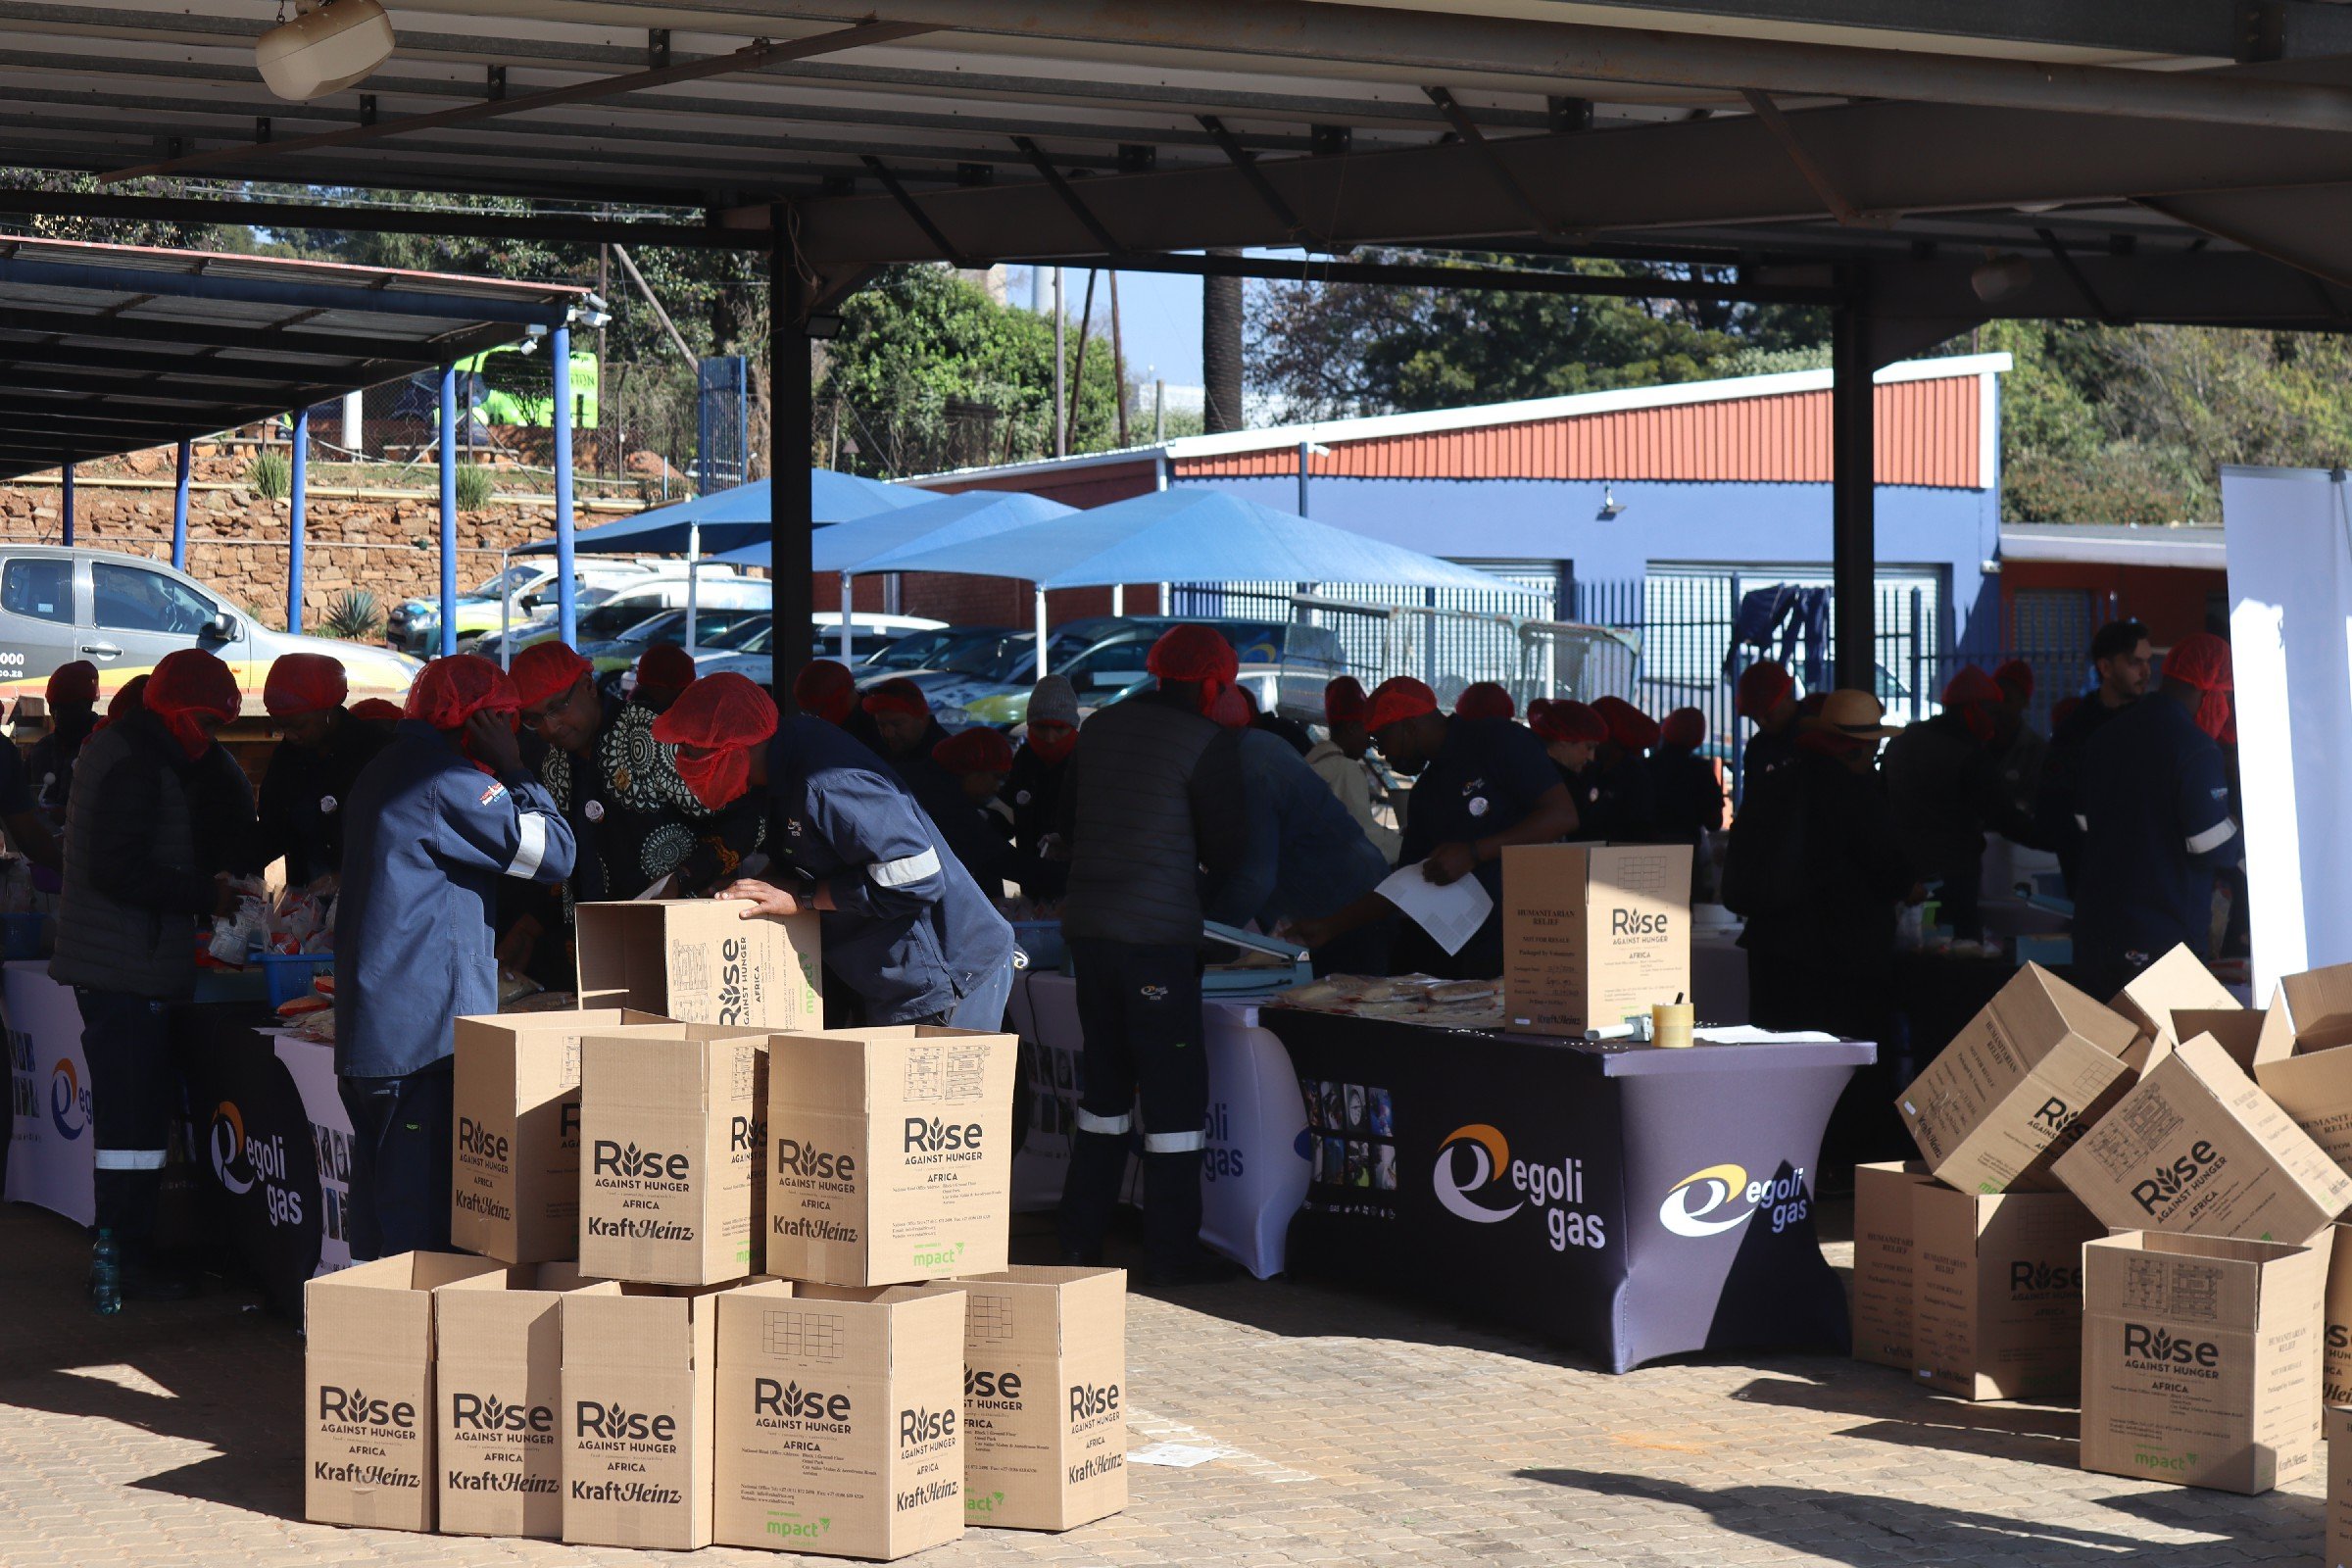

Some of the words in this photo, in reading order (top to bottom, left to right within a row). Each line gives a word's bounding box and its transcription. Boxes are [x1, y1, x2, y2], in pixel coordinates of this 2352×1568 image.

[1612, 937, 1640, 946] AGAINST
[1203, 1102, 1228, 1142] oli
[245, 1134, 286, 1182] egoli
[459, 1153, 484, 1166] AGAINST
[485, 1161, 509, 1175] HUNGER
[905, 1153, 943, 1165] AGAINST
[946, 1152, 983, 1162] HUNGER
[473, 1175, 493, 1188] AFRICA
[594, 1178, 642, 1189] AGAINST
[644, 1181, 690, 1193] HUNGER
[778, 1177, 816, 1191] AGAINST
[818, 1181, 856, 1195] HUNGER
[927, 1173, 958, 1183] AFRICA
[1512, 1156, 1584, 1206] egoli
[1745, 1167, 1803, 1204] egoli
[2157, 1188, 2192, 1224] AGAINST
[2190, 1155, 2228, 1192] HUNGER
[267, 1183, 303, 1227] gas
[622, 1200, 660, 1210] AFRICA
[801, 1199, 831, 1211] AFRICA
[2189, 1191, 2220, 1219] AFRICA
[1772, 1196, 1807, 1234] gas
[1547, 1209, 1606, 1252] gas
[913, 1249, 956, 1268] mpact
[2125, 1359, 2170, 1372] AGAINST
[2173, 1365, 2219, 1380] HUNGER
[2151, 1382, 2189, 1395] AFRICA
[977, 1401, 1023, 1411] HUNGER
[756, 1418, 803, 1430] AGAINST
[805, 1422, 852, 1435] HUNGER
[964, 1419, 993, 1429] FRICA
[1071, 1420, 1096, 1435] AGAINST
[1097, 1411, 1120, 1428] HUNGER
[320, 1424, 367, 1436] AGAINST
[370, 1428, 416, 1441] HUNGER
[454, 1432, 502, 1442] AGAINST
[507, 1434, 554, 1445] HUNGER
[577, 1441, 626, 1451] AGAINST
[629, 1444, 677, 1454] HUNGER
[783, 1441, 821, 1451] AFRICA
[901, 1446, 928, 1460] AGAINST
[930, 1437, 956, 1452] HUNGER
[1086, 1437, 1105, 1449] AFRICA
[348, 1446, 387, 1457] AFRICA
[483, 1453, 523, 1463] AFRICA
[607, 1462, 646, 1473] AFRICA
[2134, 1452, 2185, 1470] mpact
[916, 1463, 940, 1476] AFRICA
[964, 1497, 993, 1512] act
[766, 1521, 818, 1538] mpact
